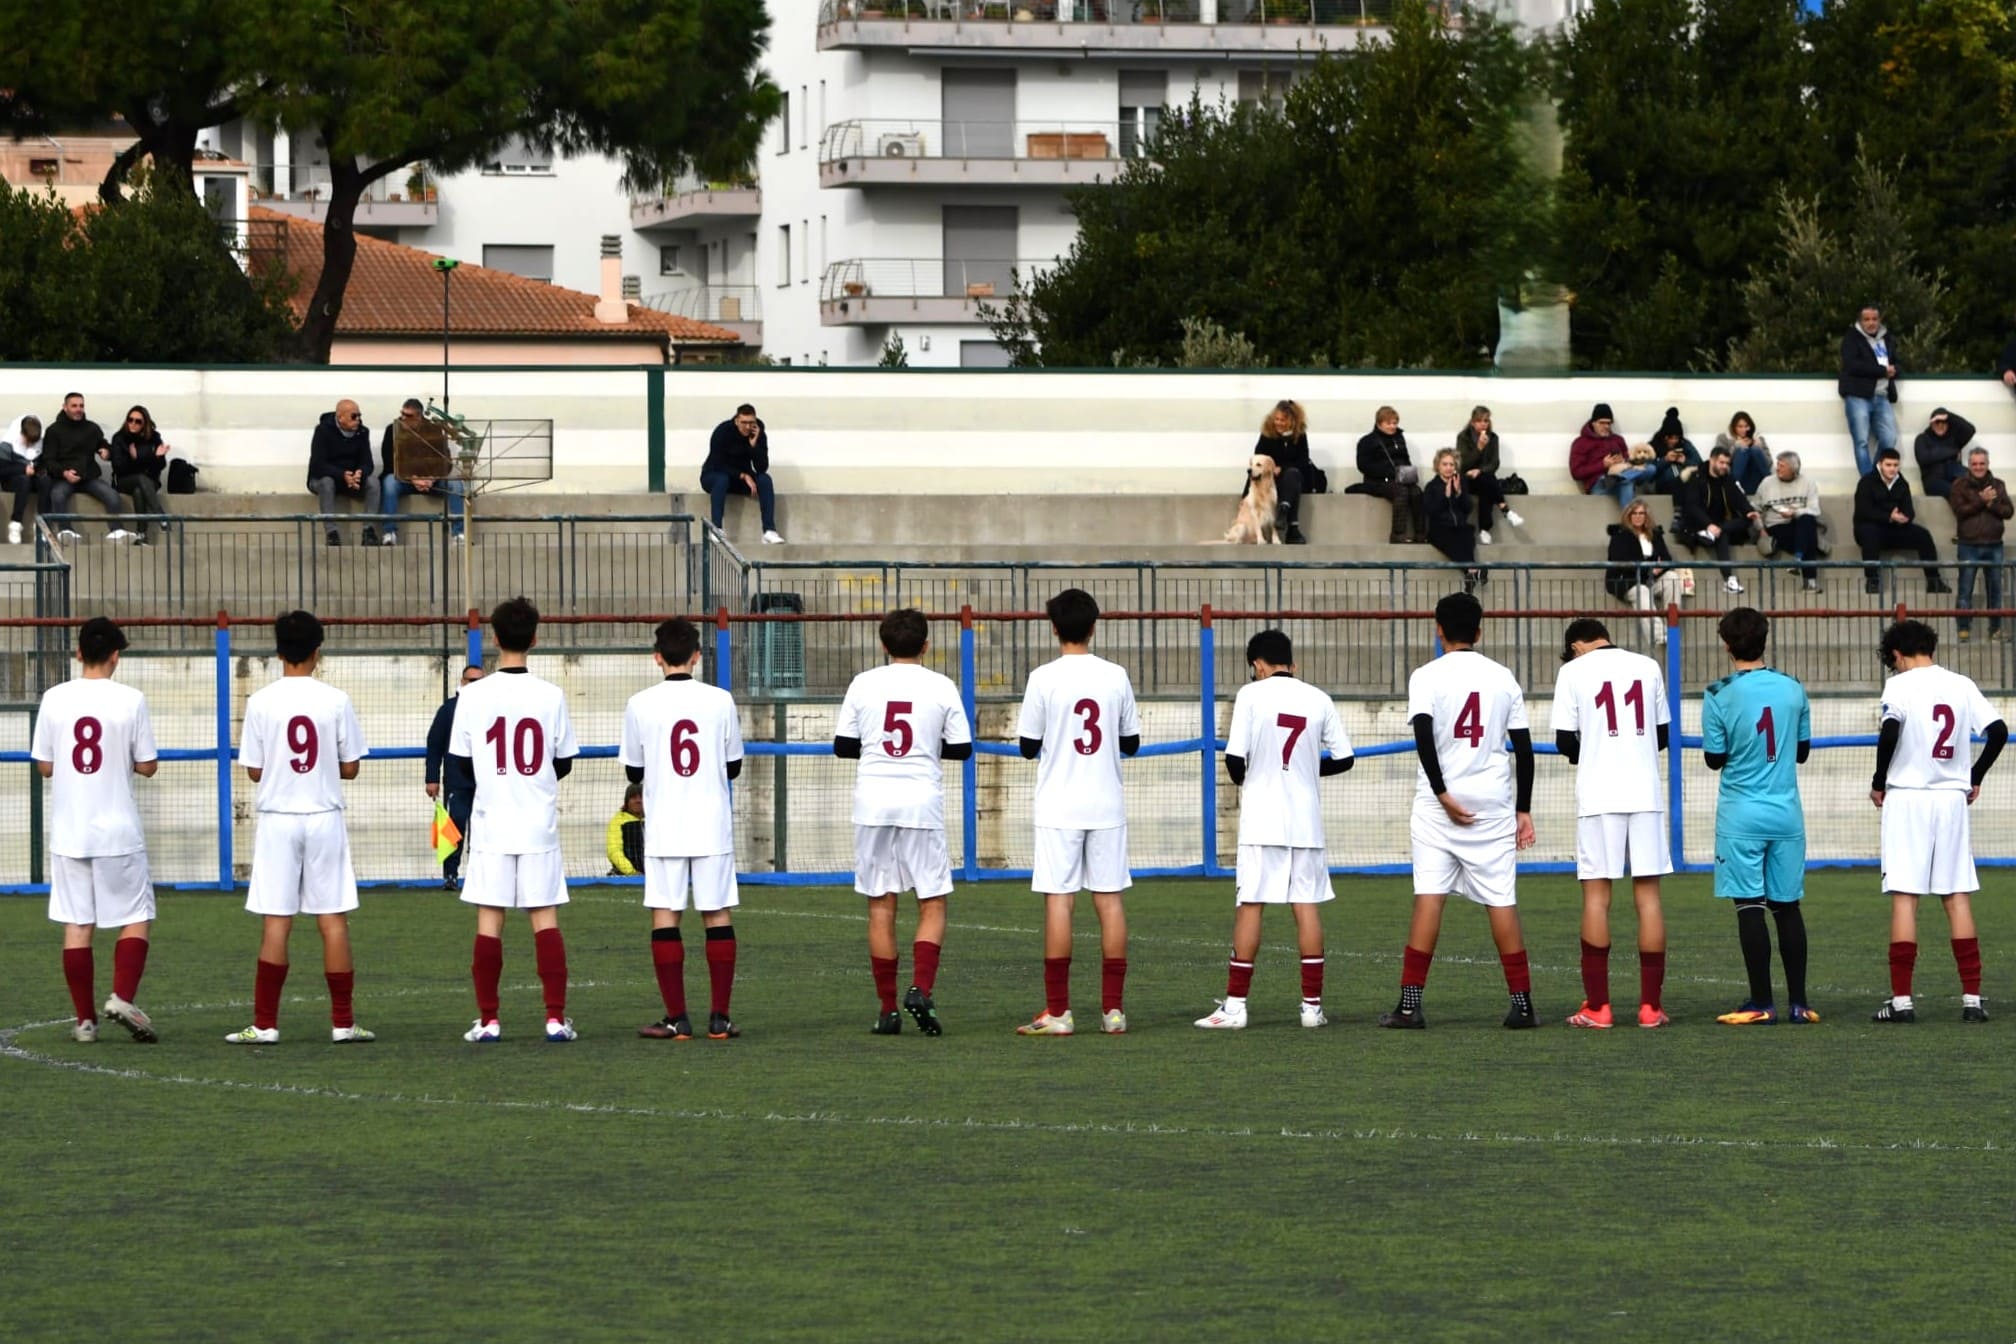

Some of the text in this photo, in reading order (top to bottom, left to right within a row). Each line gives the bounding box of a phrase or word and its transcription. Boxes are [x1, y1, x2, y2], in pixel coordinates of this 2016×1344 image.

[882, 701, 913, 757] 5
[1073, 698, 1102, 755] 3
[1454, 691, 1484, 748] 4
[1595, 680, 1645, 738] 11
[1756, 706, 1777, 763] 1
[1931, 704, 1956, 759] 2
[72, 716, 103, 774] 8
[287, 715, 319, 774] 9
[486, 716, 545, 776] 10
[670, 719, 700, 776] 6
[1277, 713, 1307, 770] 7
